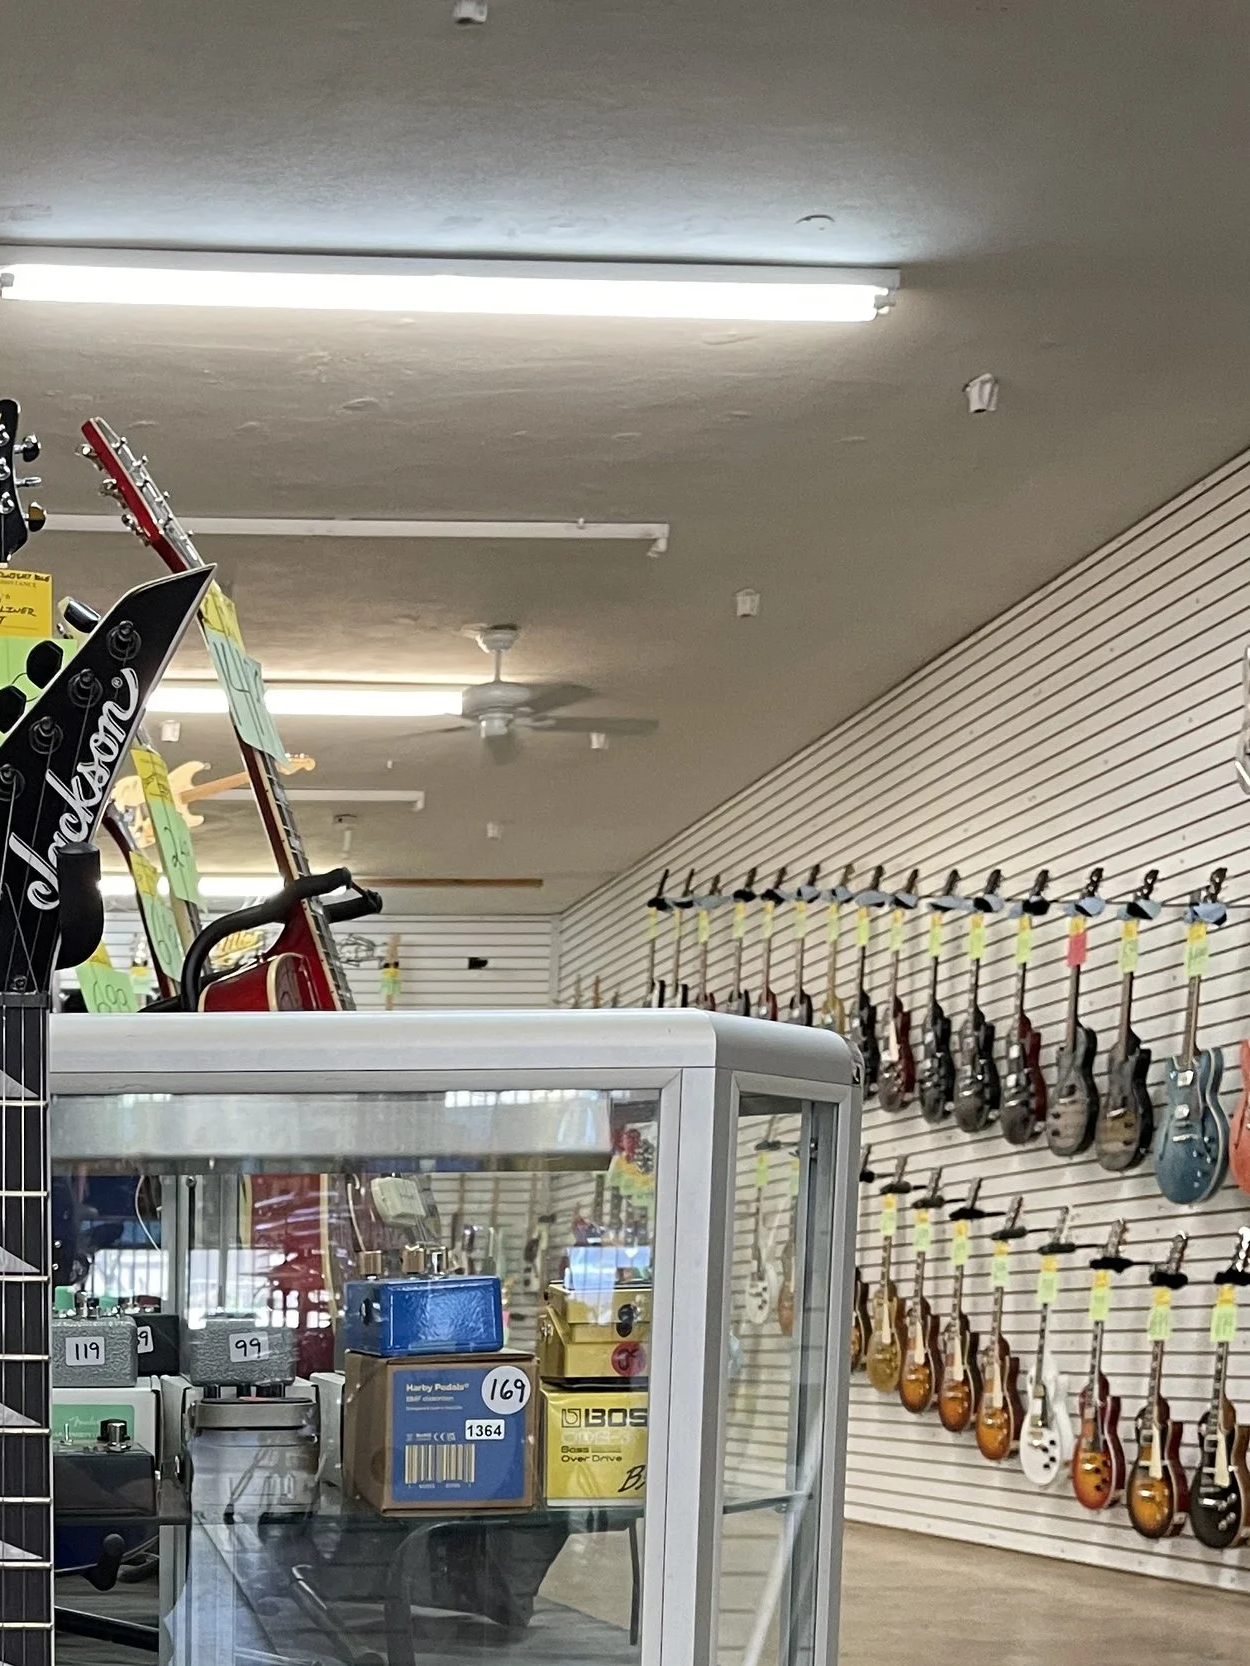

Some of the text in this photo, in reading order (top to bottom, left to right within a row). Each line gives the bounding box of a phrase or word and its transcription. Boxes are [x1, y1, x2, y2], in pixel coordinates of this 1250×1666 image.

[137, 1331, 149, 1347] 9
[75, 1341, 100, 1361] 119
[235, 1338, 261, 1359] 99
[406, 1383, 433, 1393] Harby
[490, 1378, 526, 1403] 169
[584, 1408, 648, 1428] BOS
[466, 1424, 502, 1437] 1364
[561, 1454, 623, 1463] Over Drive
